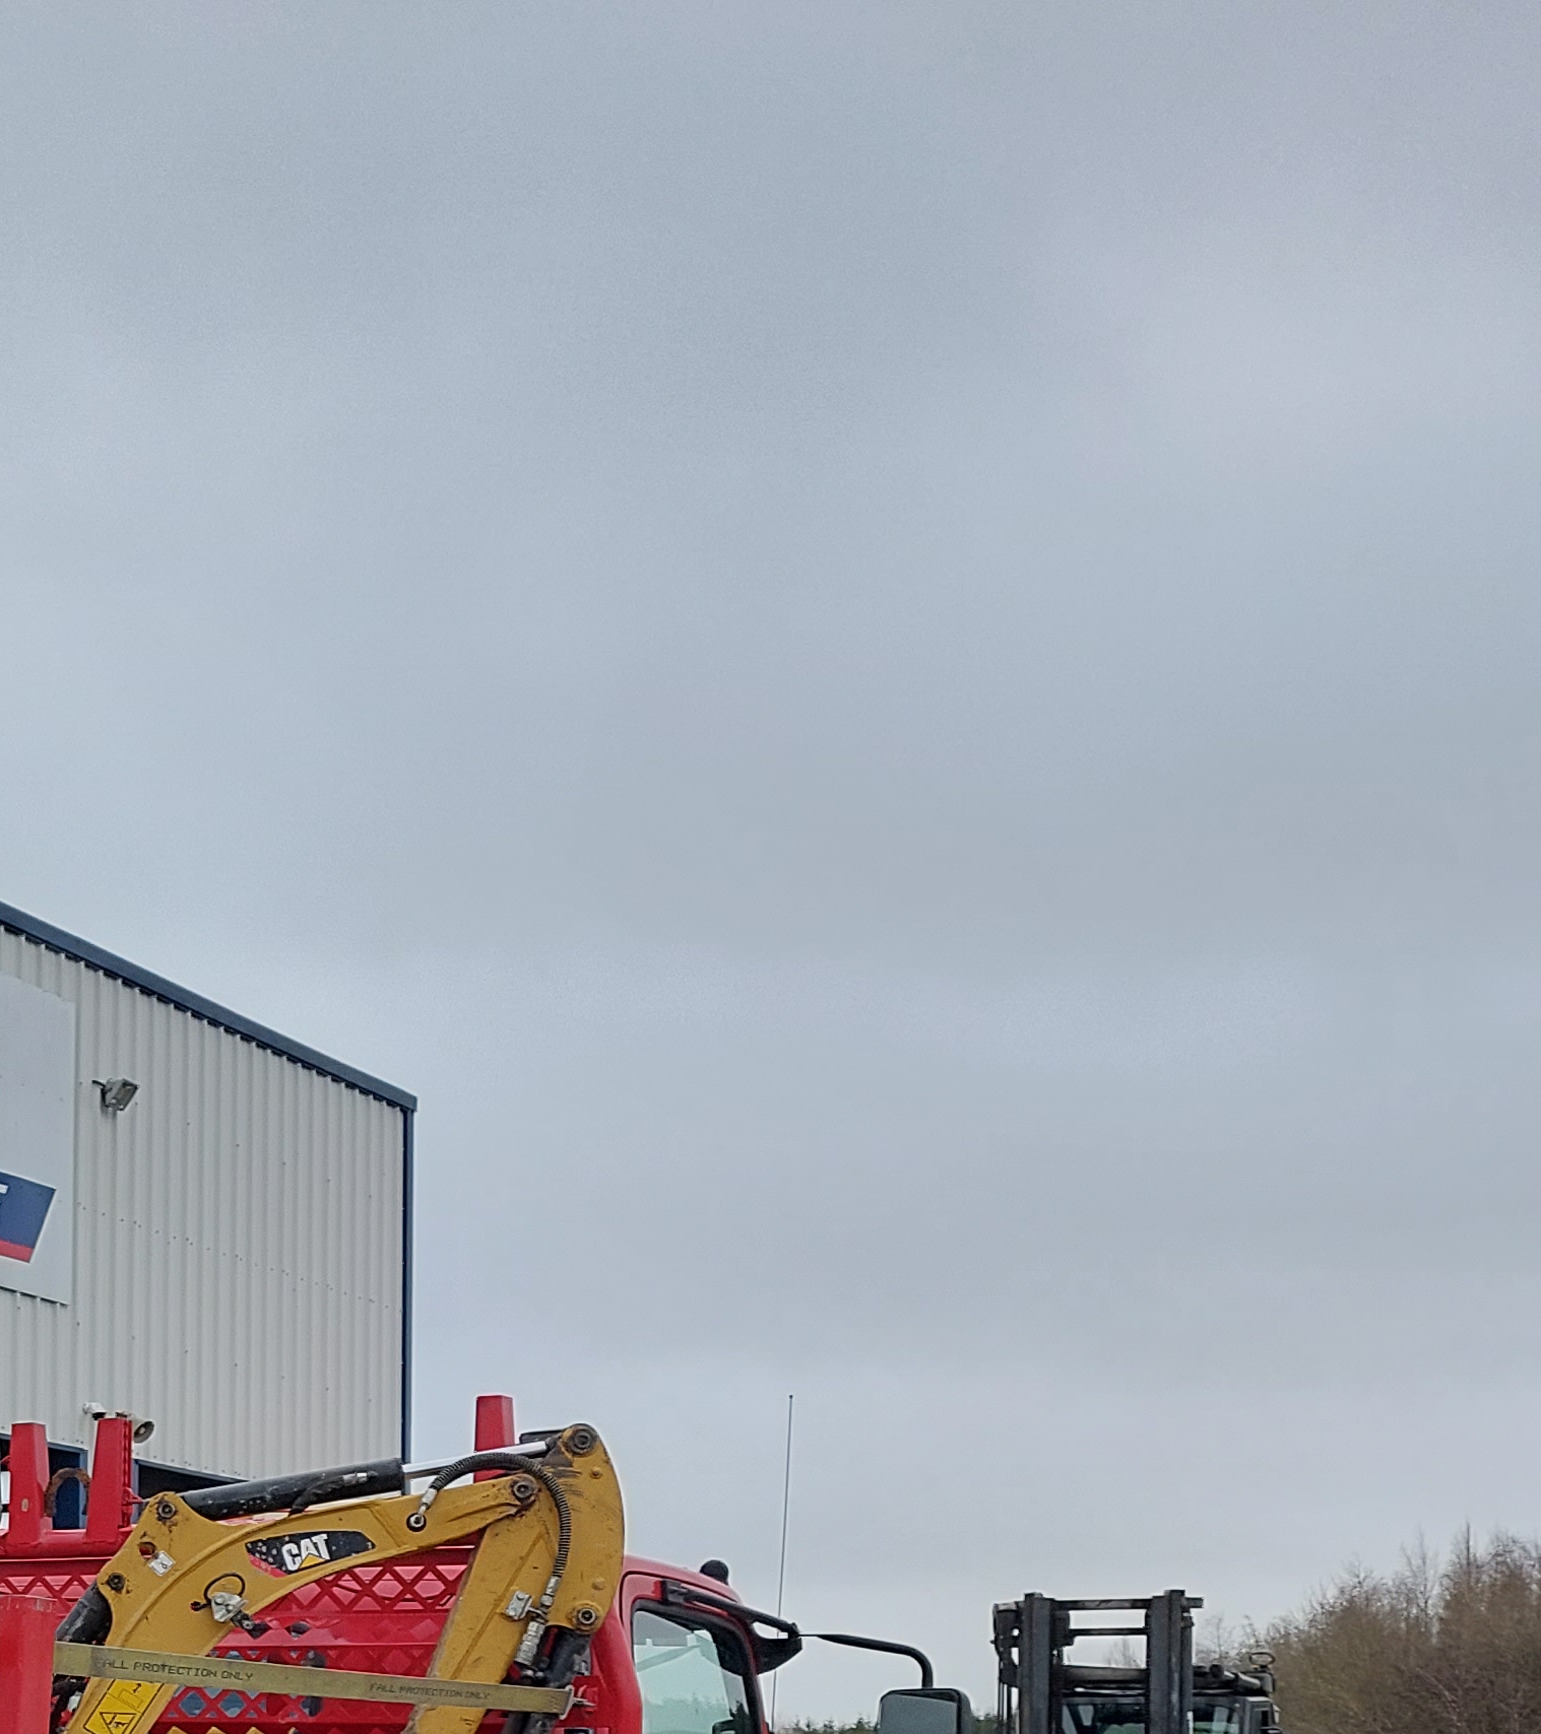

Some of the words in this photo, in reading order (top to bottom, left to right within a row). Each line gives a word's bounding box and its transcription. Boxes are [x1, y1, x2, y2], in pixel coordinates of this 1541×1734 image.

[281, 1533, 331, 1571] CAT
[134, 1661, 217, 1678] PROTECTION
[221, 1670, 253, 1681] ONLY
